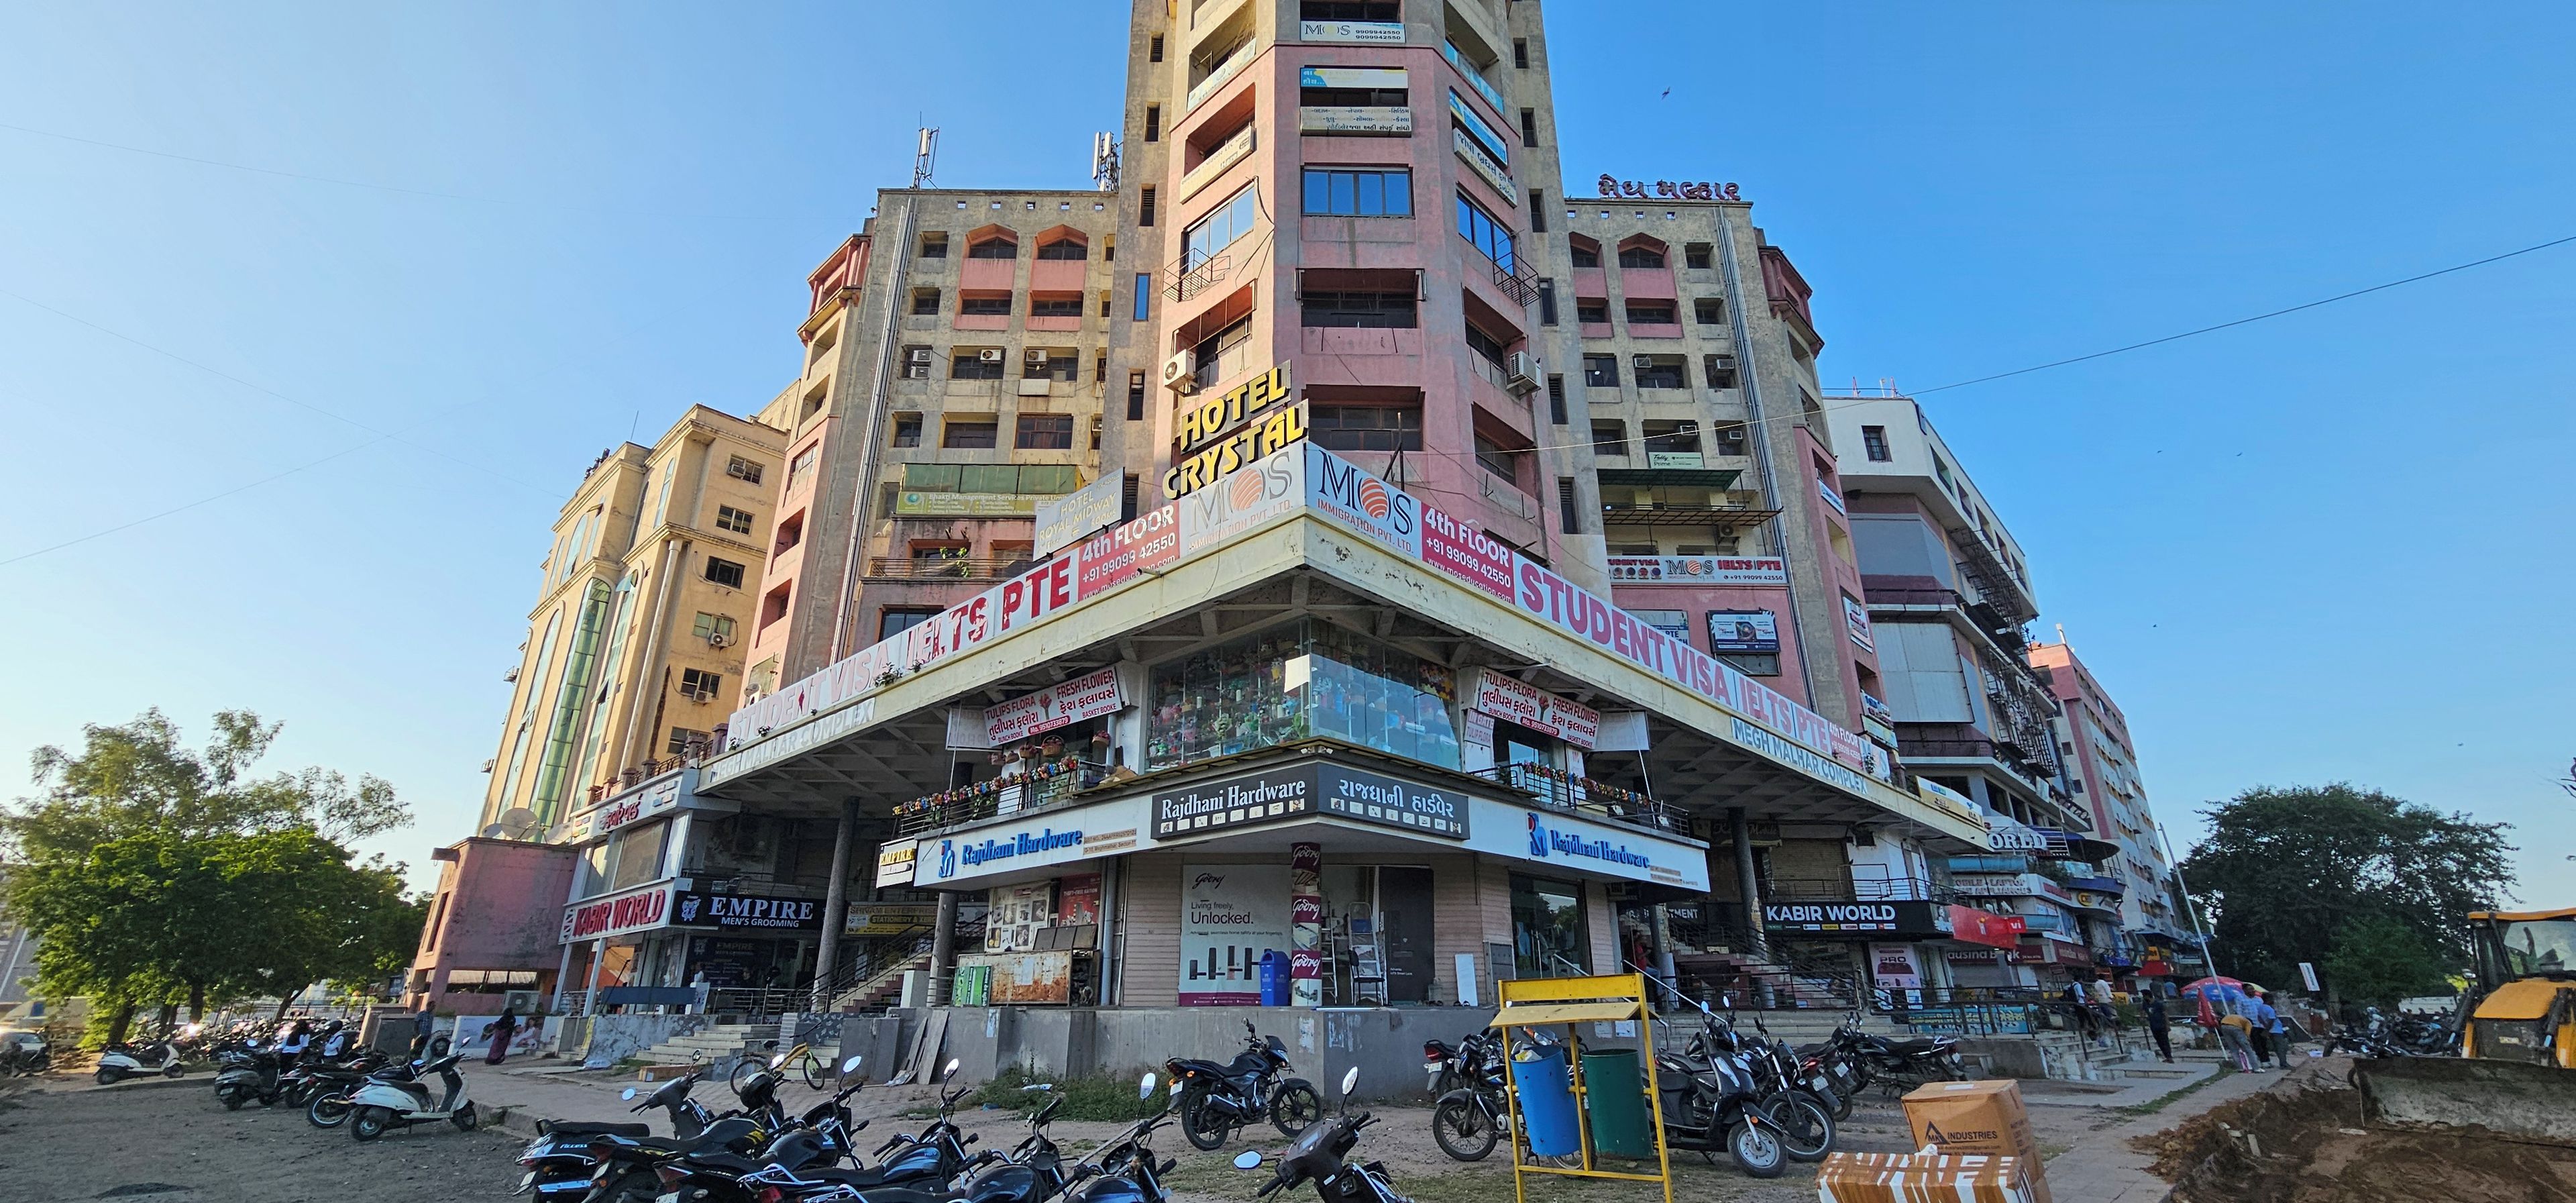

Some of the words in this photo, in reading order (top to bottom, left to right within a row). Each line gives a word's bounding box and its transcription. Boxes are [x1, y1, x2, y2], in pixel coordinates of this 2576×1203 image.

[1305, 24, 1350, 36] MOS
[1598, 173, 1648, 199] મેઘ
[1181, 367, 1289, 452] HOTEL
[1162, 406, 1305, 500] CRYSTAL
[928, 493, 950, 501] Bhakti
[1061, 490, 1094, 516] HOTEL
[1189, 451, 1293, 537] MOS
[1319, 450, 1413, 535] MOS
[1039, 517, 1070, 543] ROYAL
[1073, 492, 1116, 524] MIDWAY
[1318, 498, 1375, 534] IMMIGRATION
[1397, 537, 1413, 554] LTD.
[1082, 536, 1111, 563] 4th
[1115, 505, 1174, 550] FLOOR
[1426, 508, 1455, 539] 4th
[1459, 523, 1509, 568] FLOOR
[1083, 566, 1099, 584] +91
[1102, 550, 1136, 576] 99099
[1138, 532, 1175, 560] 42550
[1426, 537, 1444, 556] +91
[1447, 543, 1479, 572] 99099
[1481, 563, 1511, 588] 42550
[1666, 560, 1714, 575] MOS
[1717, 560, 1752, 570] IELTS
[1756, 560, 1782, 571] PTE
[1427, 557, 1512, 603] www.moseducation.com
[731, 674, 827, 741] STUDENT
[830, 642, 890, 705] VISA
[906, 596, 989, 670] IELTS
[1001, 556, 1071, 631] PTE
[1520, 562, 1665, 673] STUDENT
[1669, 639, 1732, 707] VISA
[1739, 675, 1792, 735] IELTS
[1794, 705, 1829, 754] PTE
[1057, 680, 1081, 700] FRESH
[1082, 670, 1114, 692] FLOWER
[1485, 672, 1511, 692] TULIPS
[1513, 683, 1537, 701] FLORA
[985, 704, 1011, 721] TULIPS
[1012, 696, 1036, 713] FLORA
[1082, 707, 1099, 719] BASKET
[1100, 703, 1117, 715] BOOKE
[1477, 713, 1495, 729] GATE
[1488, 707, 1503, 721] BUNCH
[1552, 696, 1574, 716] FRESH
[1574, 702, 1599, 725] FLOWER
[710, 751, 741, 783] MEGH
[800, 700, 871, 745] COMPLEX
[1566, 734, 1580, 745] BASKET
[1829, 721, 1839, 737] 4th
[1839, 727, 1859, 748] FLOOR
[1733, 718, 1771, 753] MEGH
[1773, 737, 1820, 775] MALHAR
[1821, 760, 1869, 796] COMPLEX
[1162, 790, 1224, 820] Rajdhani
[1227, 778, 1305, 809] Hardware
[1339, 778, 1405, 808] રાજધાની
[1411, 794, 1454, 819] હાર્ડવેર
[961, 835, 1015, 866] Rajdhani
[1016, 827, 1083, 857] Hardware
[1550, 829, 1599, 860] Rajdhani
[1601, 840, 1650, 869] Hardware
[1987, 832, 2046, 850] ORLD
[880, 848, 916, 866] EMPIRE
[1293, 845, 1321, 866] Godrej
[1192, 873, 1226, 889] Godrej
[1955, 879, 1983, 887] OBILE
[572, 900, 610, 937] KABIR
[611, 889, 665, 930] WORLD
[709, 896, 814, 921] EMPIRE
[884, 906, 937, 914] ENTERPRISE
[1191, 901, 1212, 910] Living
[1214, 901, 1234, 910] freely,
[1191, 911, 1254, 925] Unlocked.
[1293, 898, 1321, 920] Godrej
[1668, 908, 1698, 919] TMENT
[1766, 906, 1823, 921] KABIR
[1826, 906, 1896, 921] WORLD
[721, 917, 750, 927] MEN'S
[751, 917, 800, 928] GROOMING
[2010, 920, 2021, 929] vi
[1292, 953, 1321, 976] Godrej
[1947, 1131, 1998, 1140] INDUSTRIES
